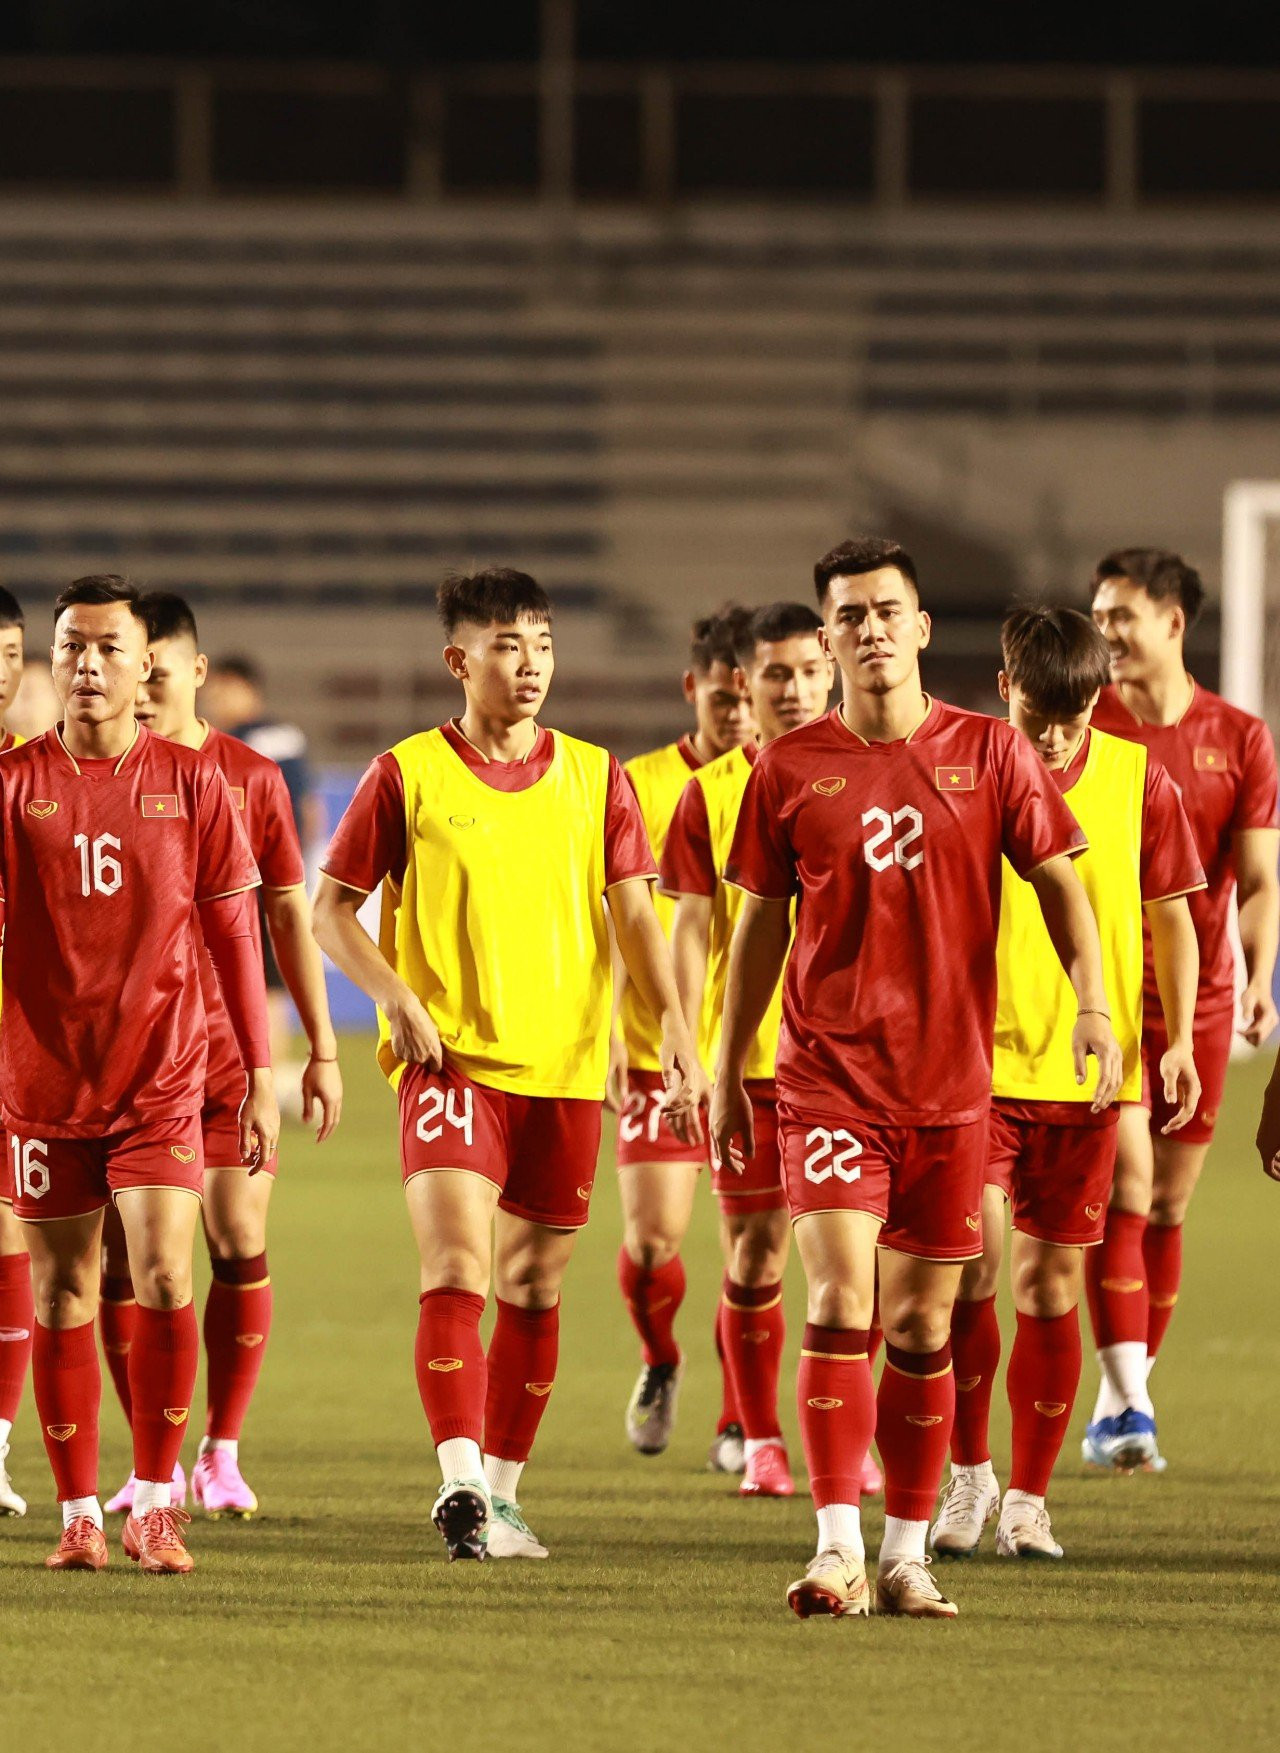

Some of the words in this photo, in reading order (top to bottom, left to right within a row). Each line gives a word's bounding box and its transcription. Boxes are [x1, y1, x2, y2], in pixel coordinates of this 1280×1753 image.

[74, 831, 123, 897] 16
[861, 804, 924, 873] 22
[416, 1086, 474, 1147] 24
[11, 1134, 51, 1200] 16
[804, 1126, 863, 1184] 22
